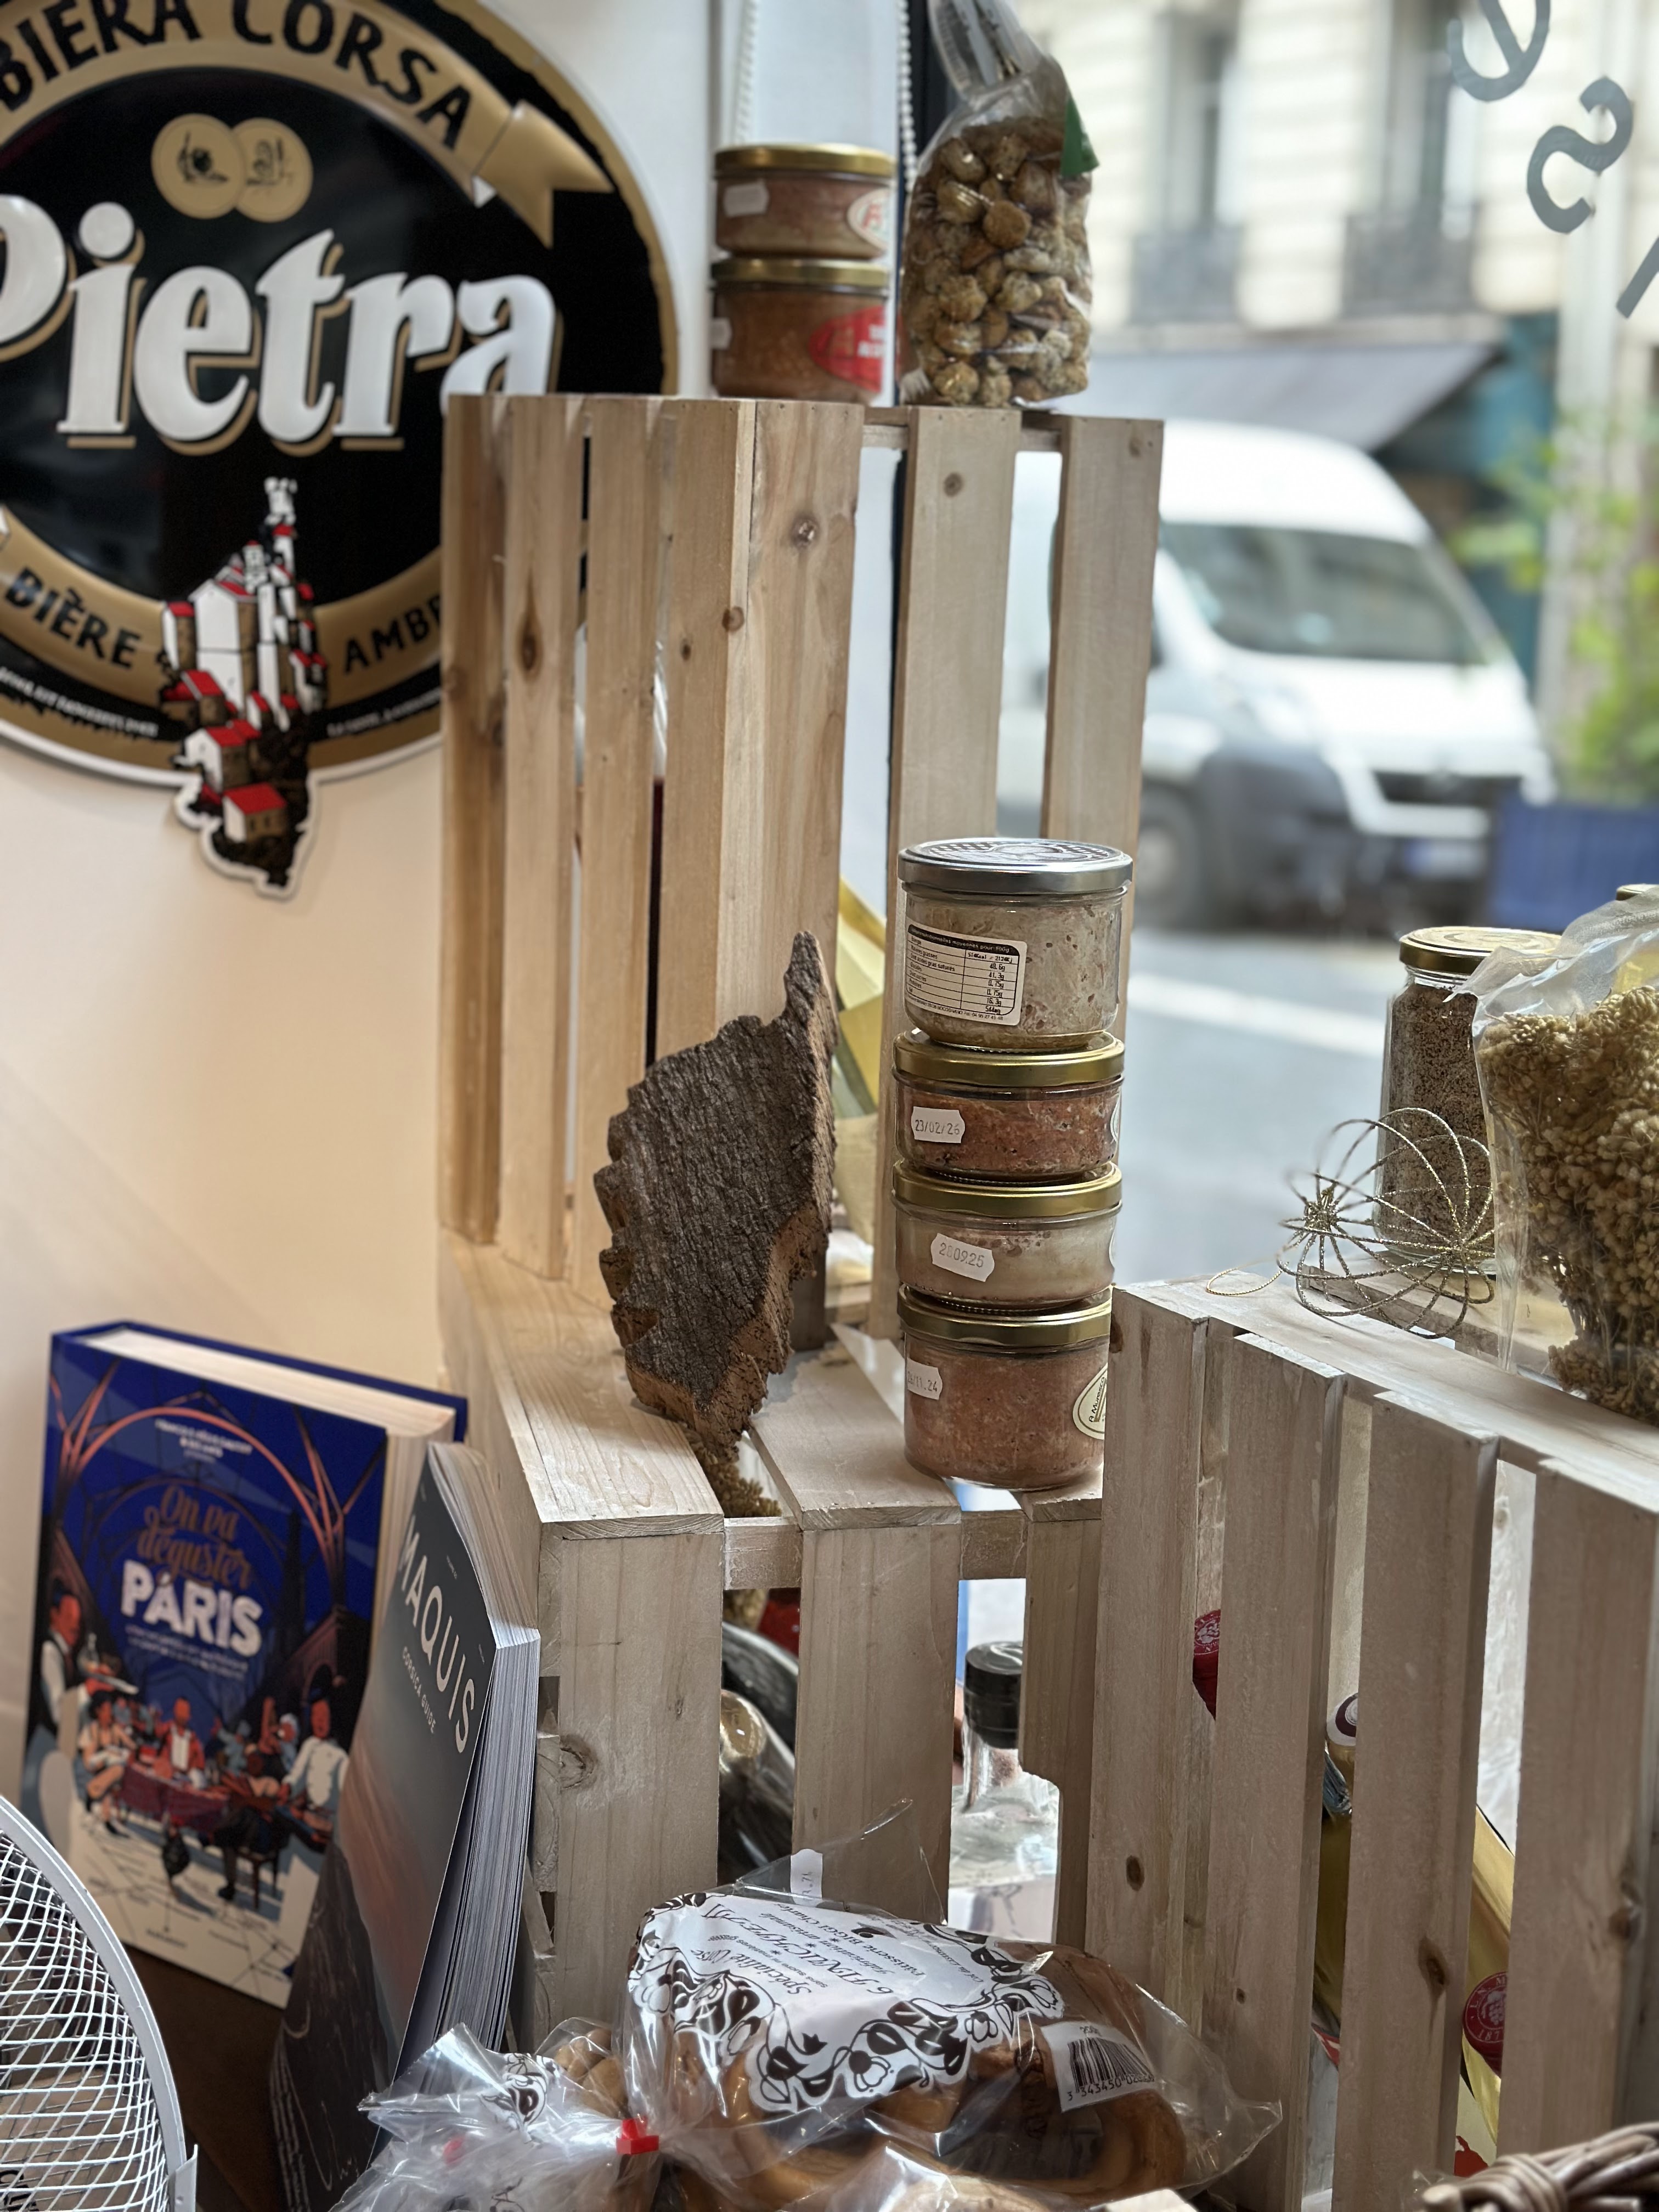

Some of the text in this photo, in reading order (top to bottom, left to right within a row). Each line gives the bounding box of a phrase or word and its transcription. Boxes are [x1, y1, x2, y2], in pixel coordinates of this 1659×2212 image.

[0, 0, 474, 147] BIERA CORSA
[5, 566, 142, 669] BIÈRE
[915, 1119, 960, 1135] 23/02/26
[161, 1485, 200, 1531] On
[120, 1559, 263, 1657] PARIS
[398, 1515, 475, 1754] MAQUIS
[403, 1646, 436, 1734] CORSICA GUIDE
[758, 1913, 896, 1974] Fabrication artisanale
[818, 1925, 864, 1944] BIGGI
[730, 1953, 812, 1995] Spécialité
[866, 1986, 894, 1994] 6
